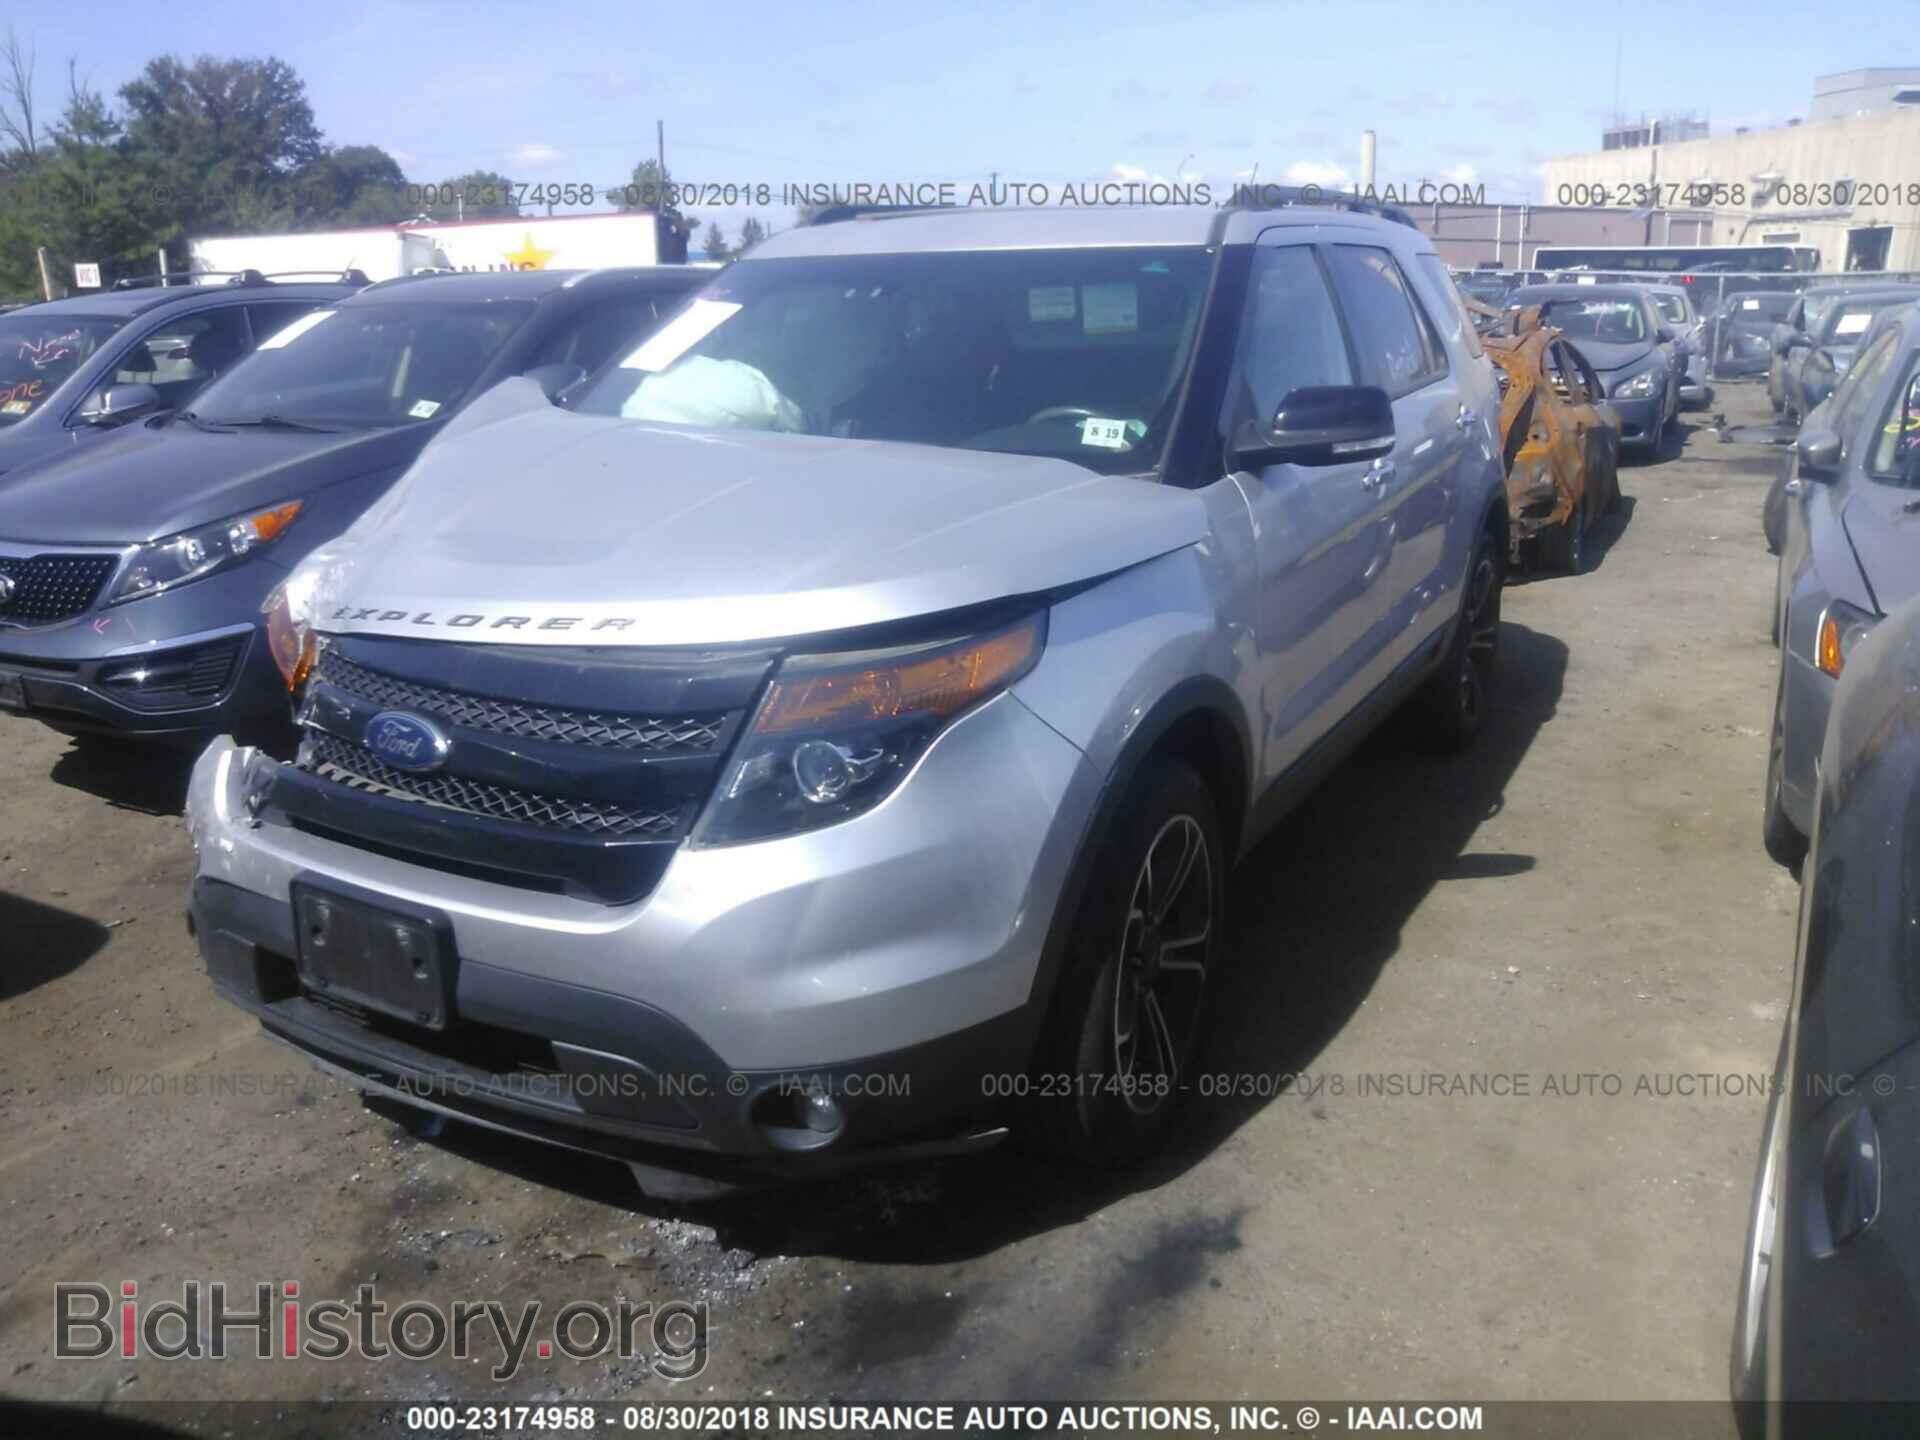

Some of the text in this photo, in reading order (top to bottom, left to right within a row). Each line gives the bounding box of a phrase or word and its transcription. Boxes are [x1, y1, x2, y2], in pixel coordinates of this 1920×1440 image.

[1105, 427, 1120, 439] 19
[331, 605, 637, 631] EXPLORER
[377, 719, 424, 759] Ford
